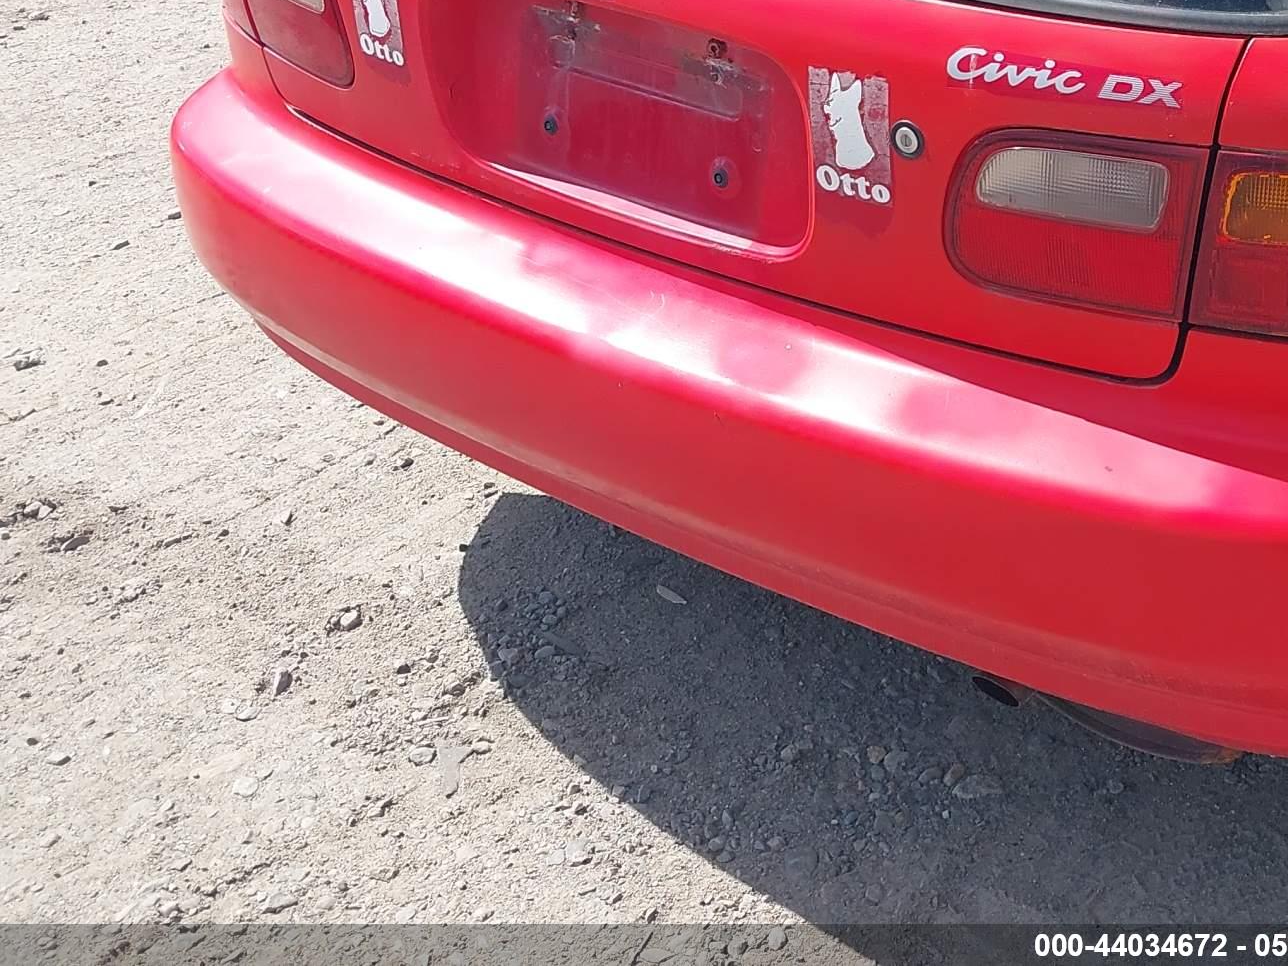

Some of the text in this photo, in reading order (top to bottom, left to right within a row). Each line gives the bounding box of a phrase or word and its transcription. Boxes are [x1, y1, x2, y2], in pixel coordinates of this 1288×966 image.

[360, 33, 404, 66] Otto
[946, 46, 1183, 108] Civic DX
[816, 165, 890, 203] Otto
